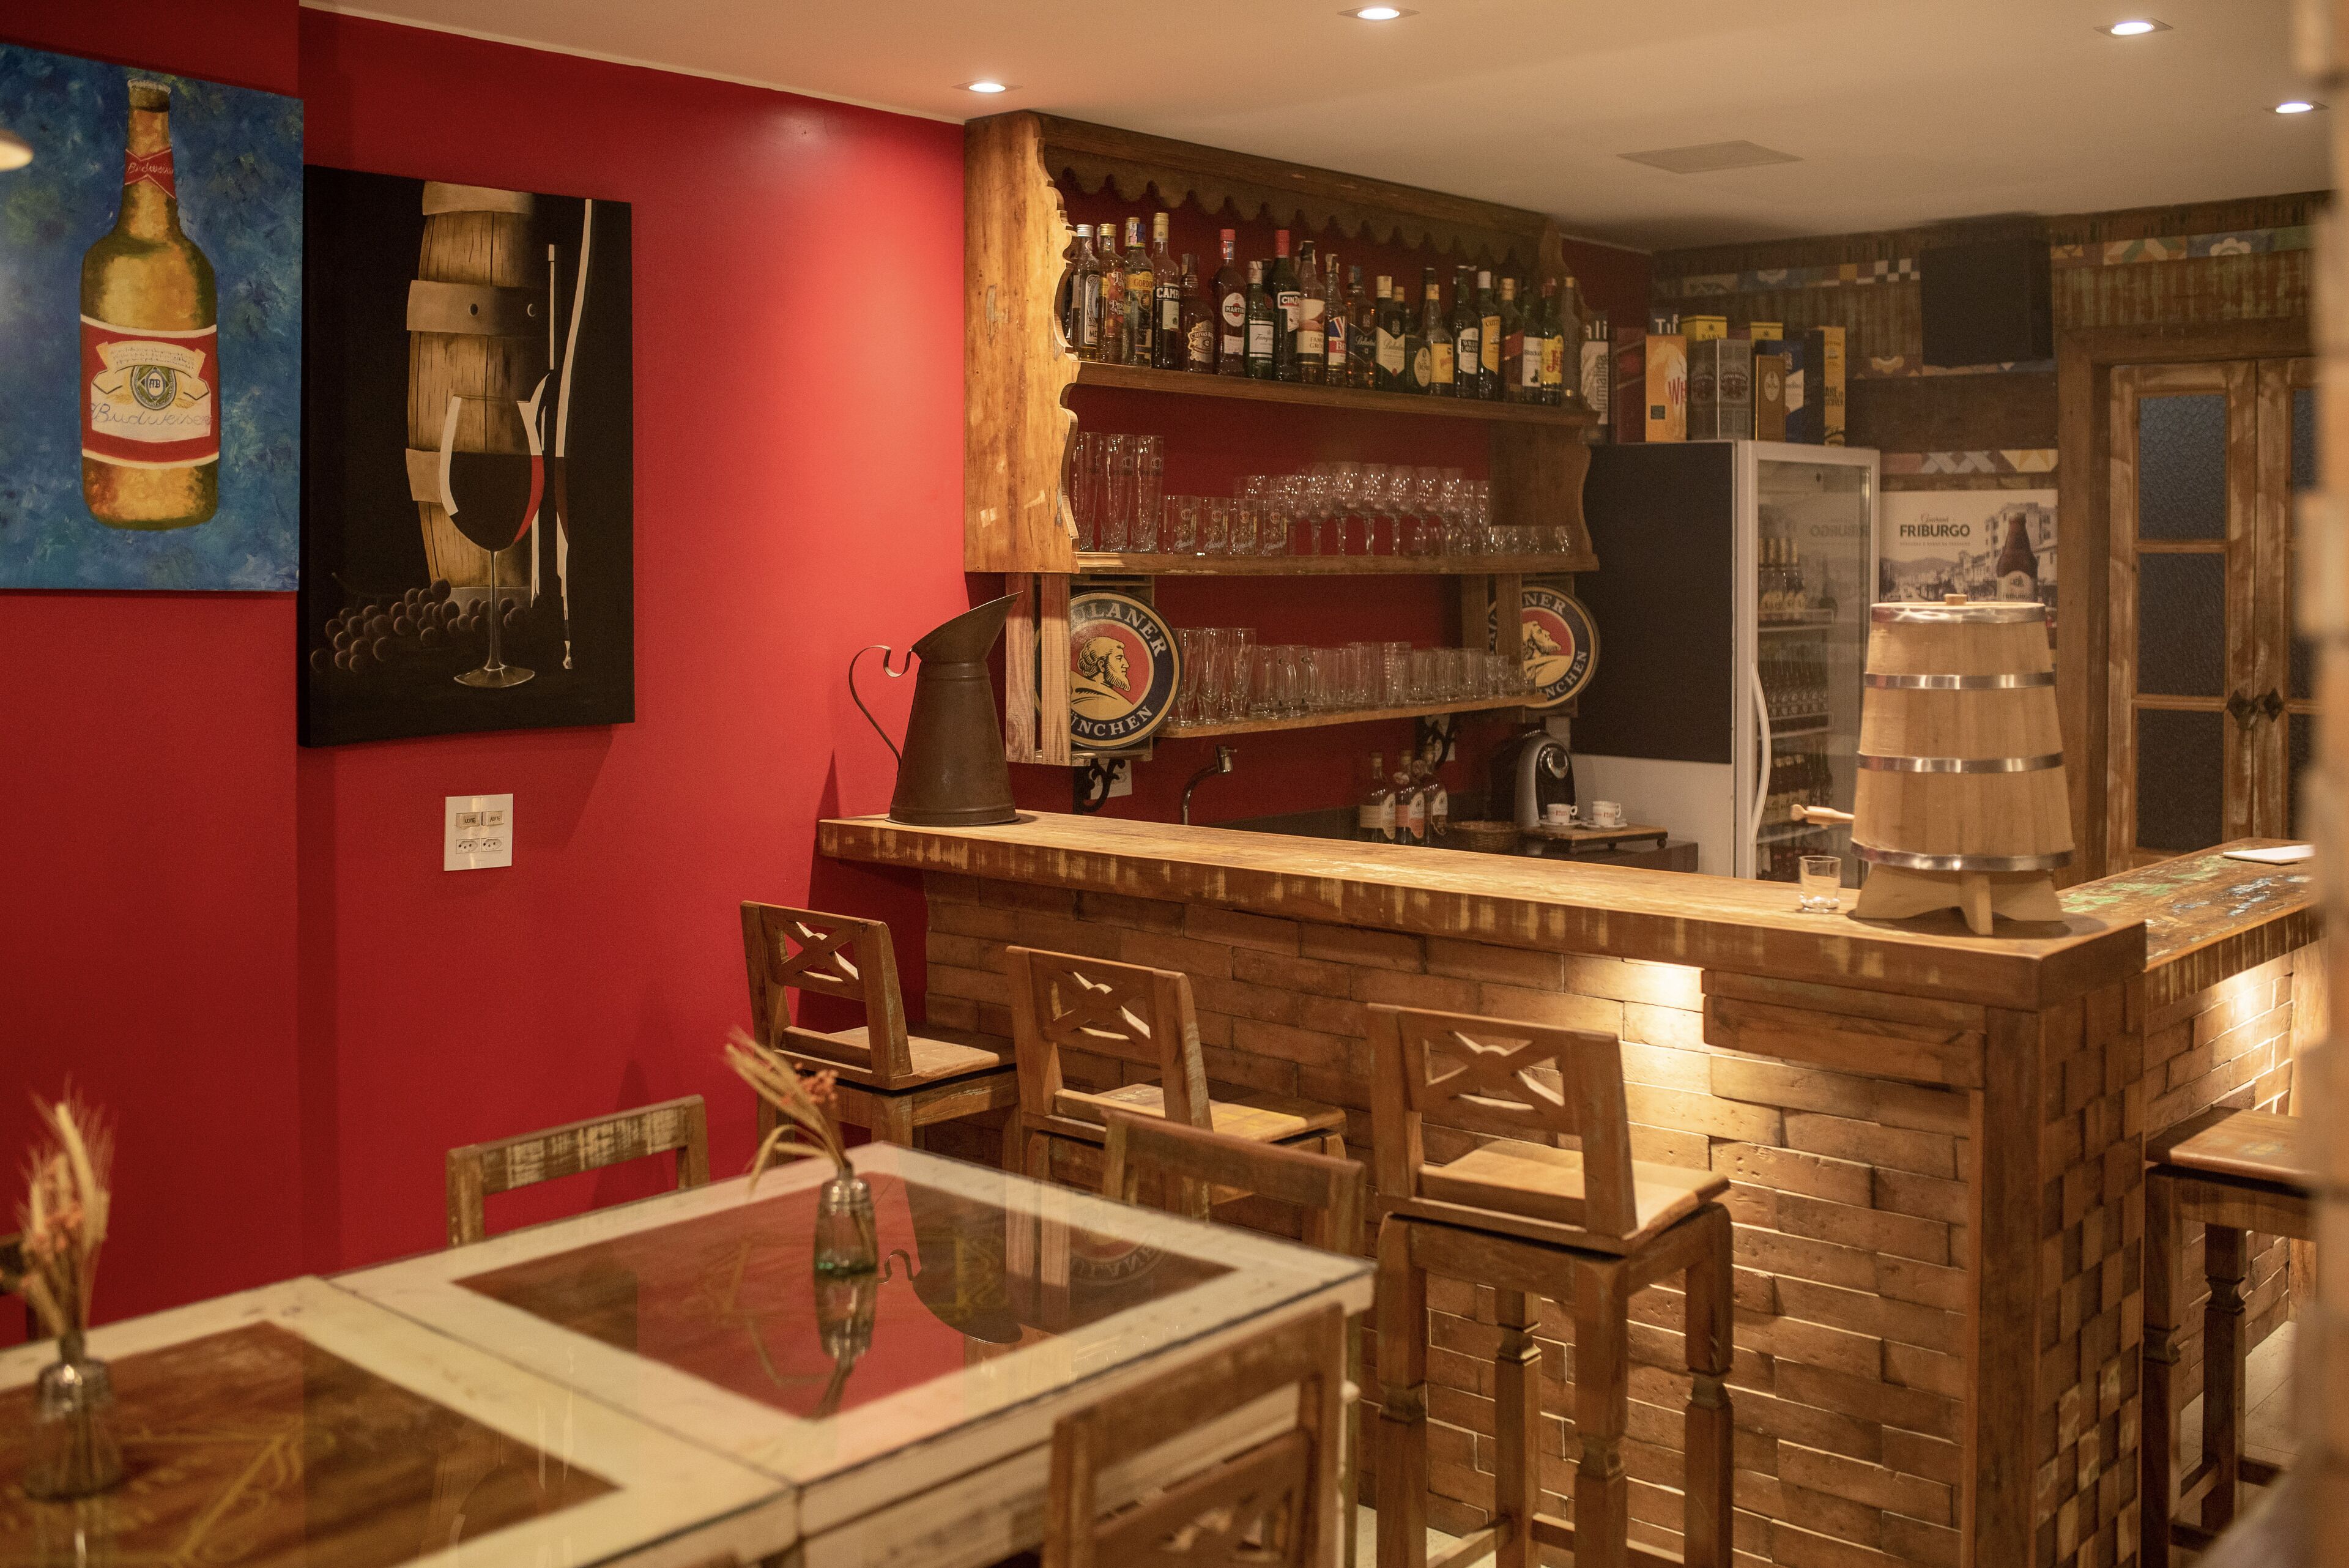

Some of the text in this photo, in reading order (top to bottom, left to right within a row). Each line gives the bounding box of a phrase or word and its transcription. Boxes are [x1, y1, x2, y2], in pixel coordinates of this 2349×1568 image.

[1156, 288, 1179, 299] CAMP
[1281, 296, 1299, 305] CINZ
[1900, 524, 1970, 537] FRIBURGO
[1545, 650, 1587, 697] NCHEN
[1071, 705, 1153, 737] ÜNCHEN
